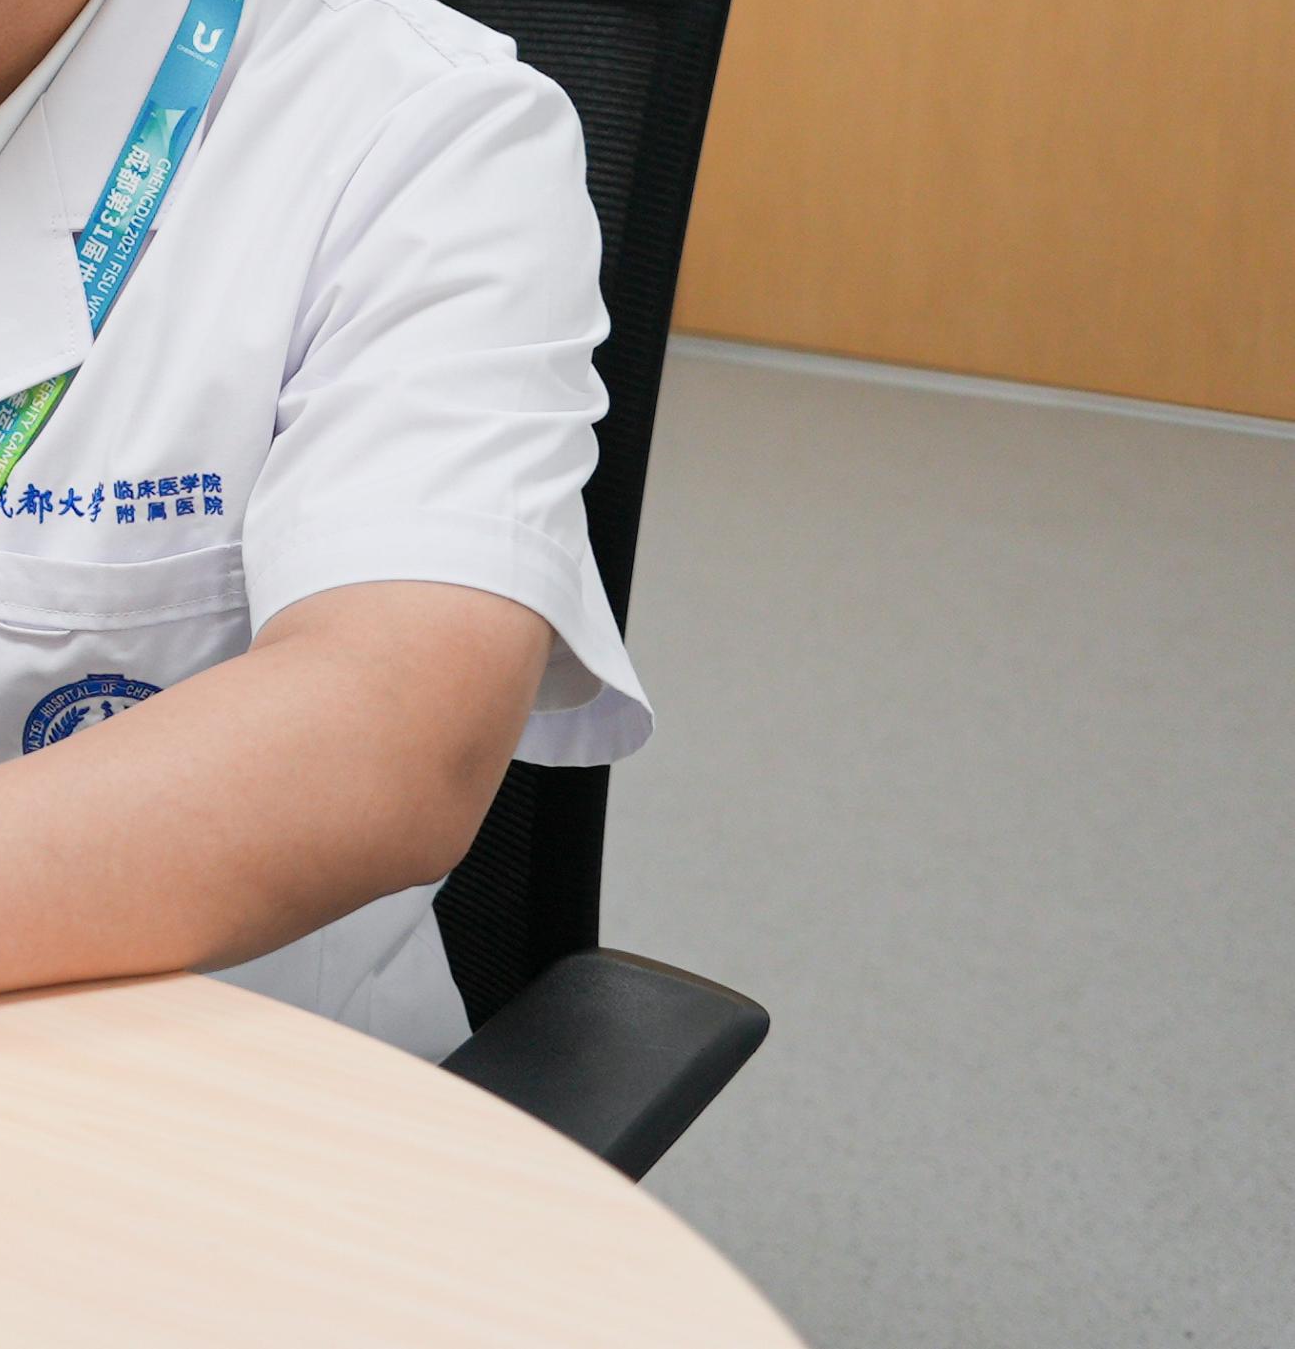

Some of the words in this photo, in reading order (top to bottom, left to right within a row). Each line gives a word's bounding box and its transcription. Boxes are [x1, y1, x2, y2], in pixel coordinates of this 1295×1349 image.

[130, 158, 172, 229] CHENGDU
[117, 229, 140, 261] 2021
[97, 261, 123, 295] FISU
[113, 473, 223, 500] 临床医学院
[115, 495, 224, 525] 附属医院
[40, 685, 93, 719] HOSPITAL
[101, 683, 118, 694] OF
